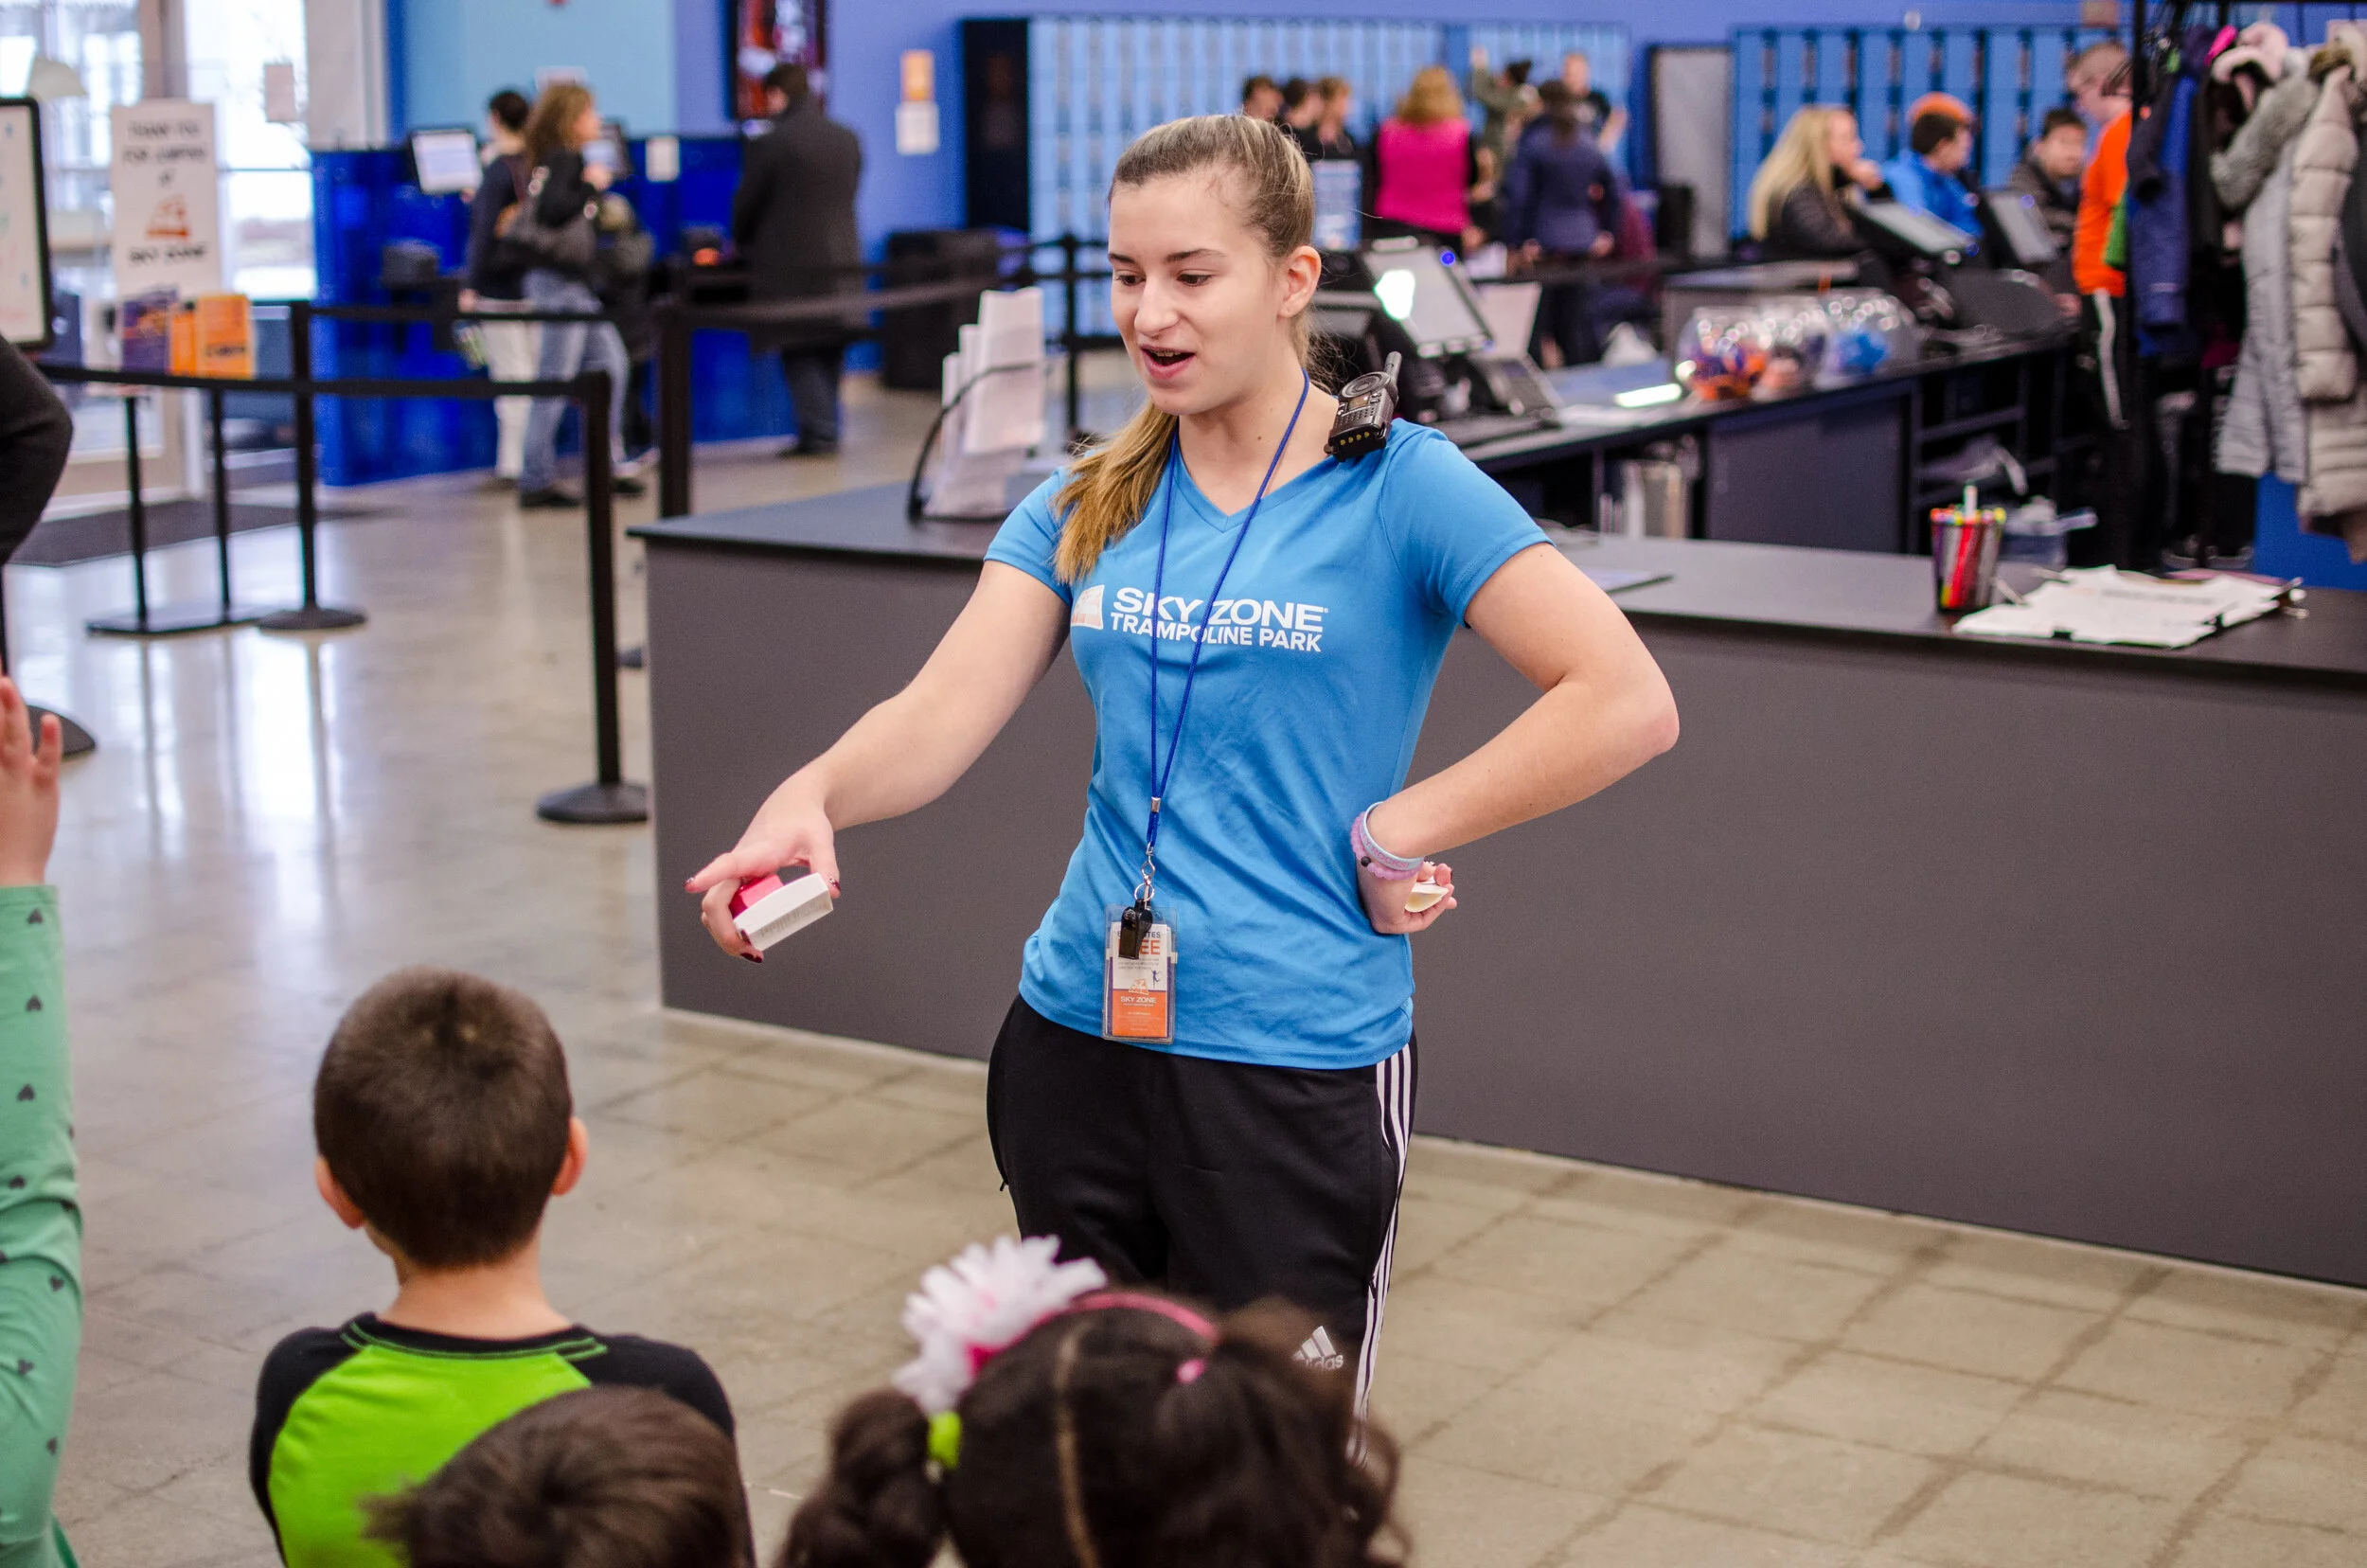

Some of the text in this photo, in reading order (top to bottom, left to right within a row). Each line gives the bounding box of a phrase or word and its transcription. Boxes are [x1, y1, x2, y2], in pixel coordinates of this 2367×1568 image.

[1112, 586, 1324, 633] SKY ZONE
[1111, 612, 1322, 652] TRAMPOLINE PARK
[1120, 995, 1135, 1004] SKY
